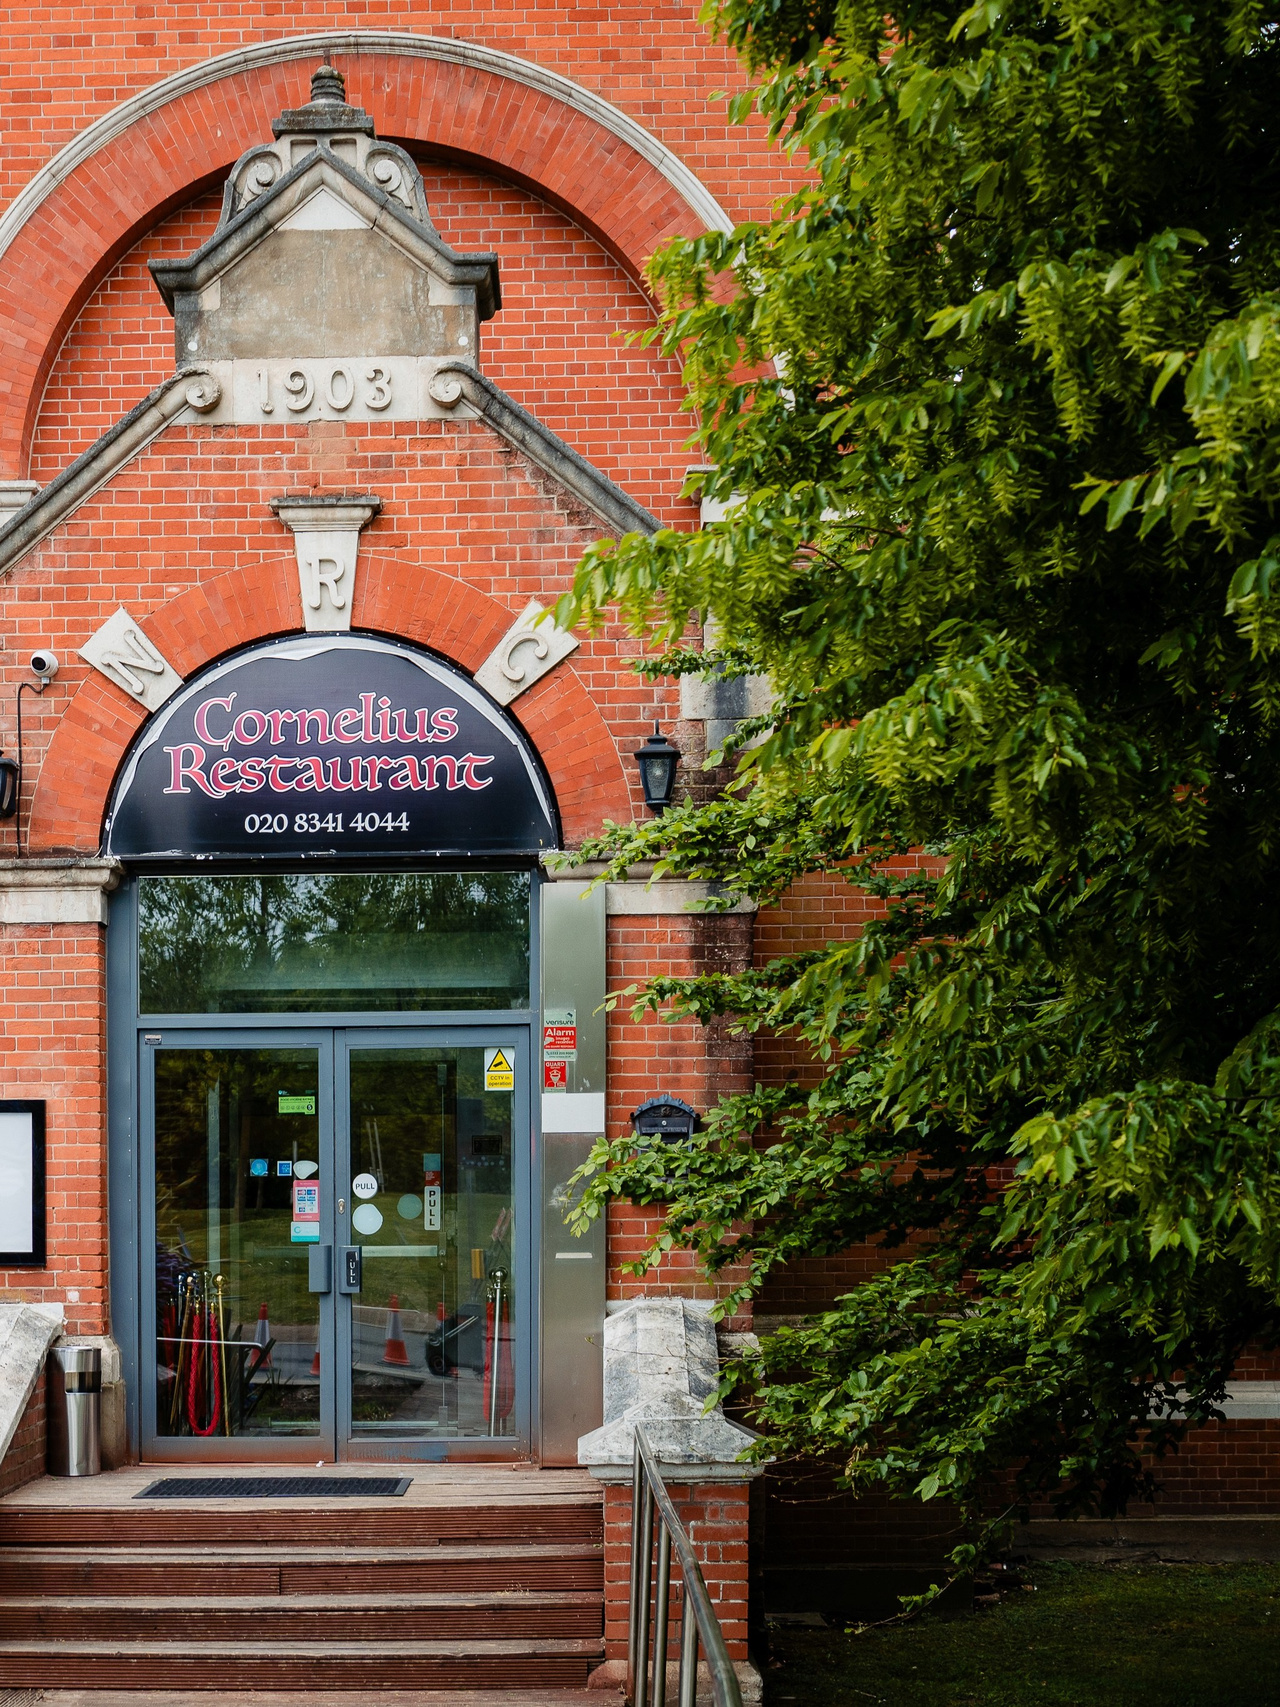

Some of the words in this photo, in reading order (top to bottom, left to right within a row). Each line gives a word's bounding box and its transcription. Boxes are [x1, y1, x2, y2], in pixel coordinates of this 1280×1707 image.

[257, 368, 393, 414] 1903
[101, 629, 165, 696] N
[306, 555, 346, 610] R
[500, 631, 549, 682] C
[194, 691, 459, 751] Cornelius
[162, 743, 496, 799] Restaurant
[244, 813, 288, 834] 020
[293, 812, 344, 833] 8341
[349, 811, 410, 832] 4044
[546, 1028, 574, 1036] Alarm
